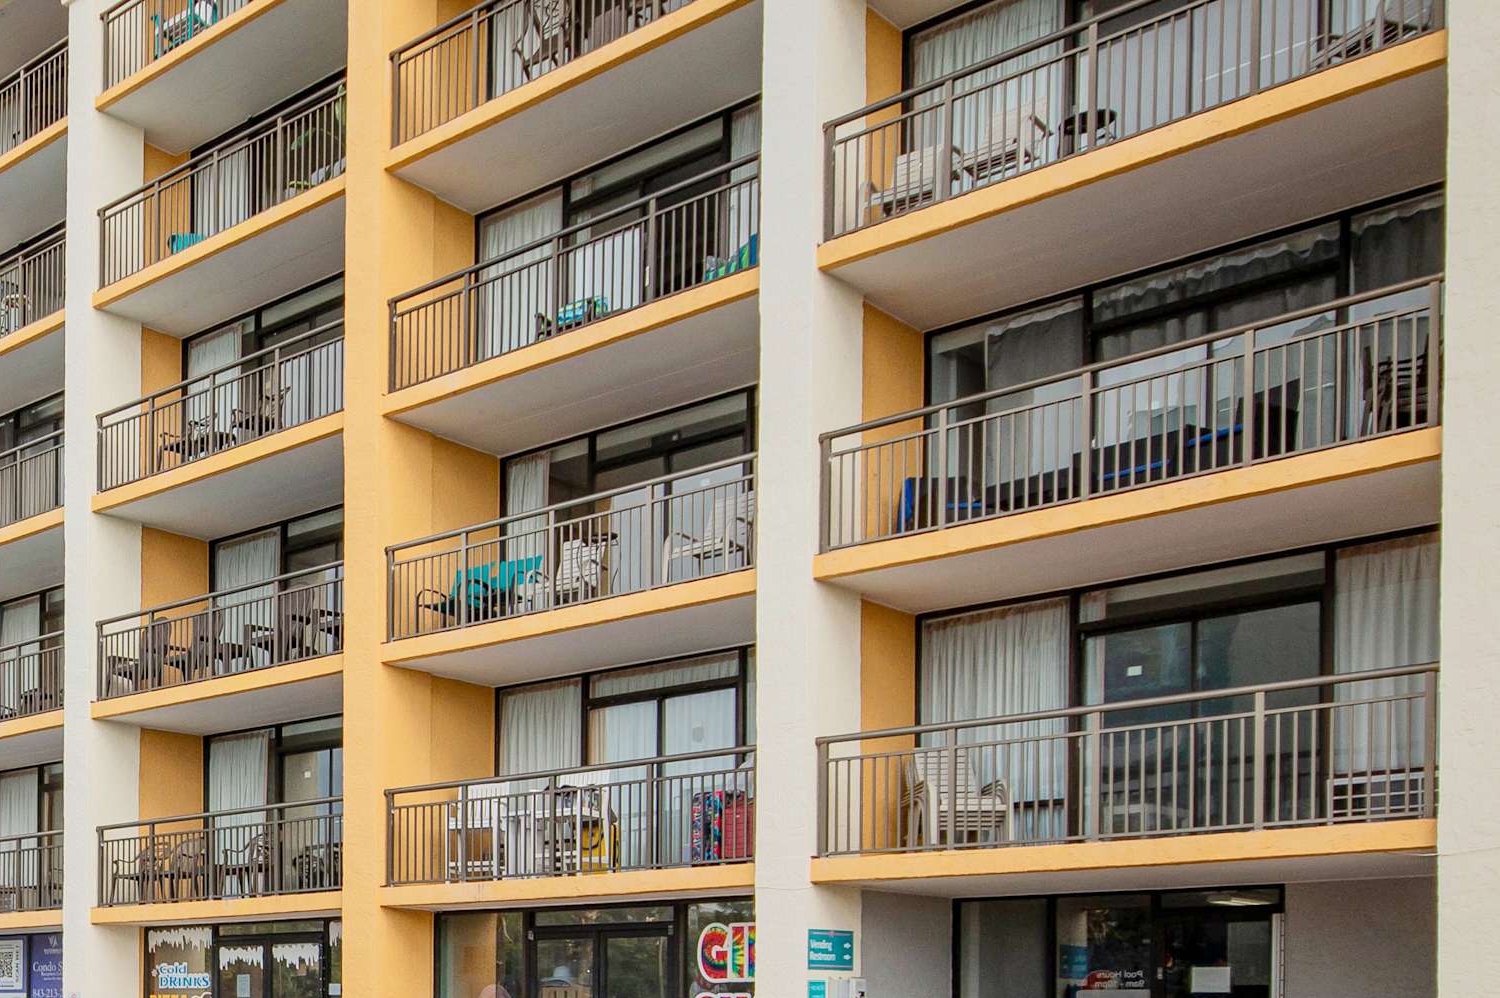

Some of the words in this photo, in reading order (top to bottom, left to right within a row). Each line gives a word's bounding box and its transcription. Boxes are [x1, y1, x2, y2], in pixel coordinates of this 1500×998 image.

[33, 962, 56, 972] Condo
[159, 962, 188, 975] Cold
[159, 974, 210, 988] DRINKS
